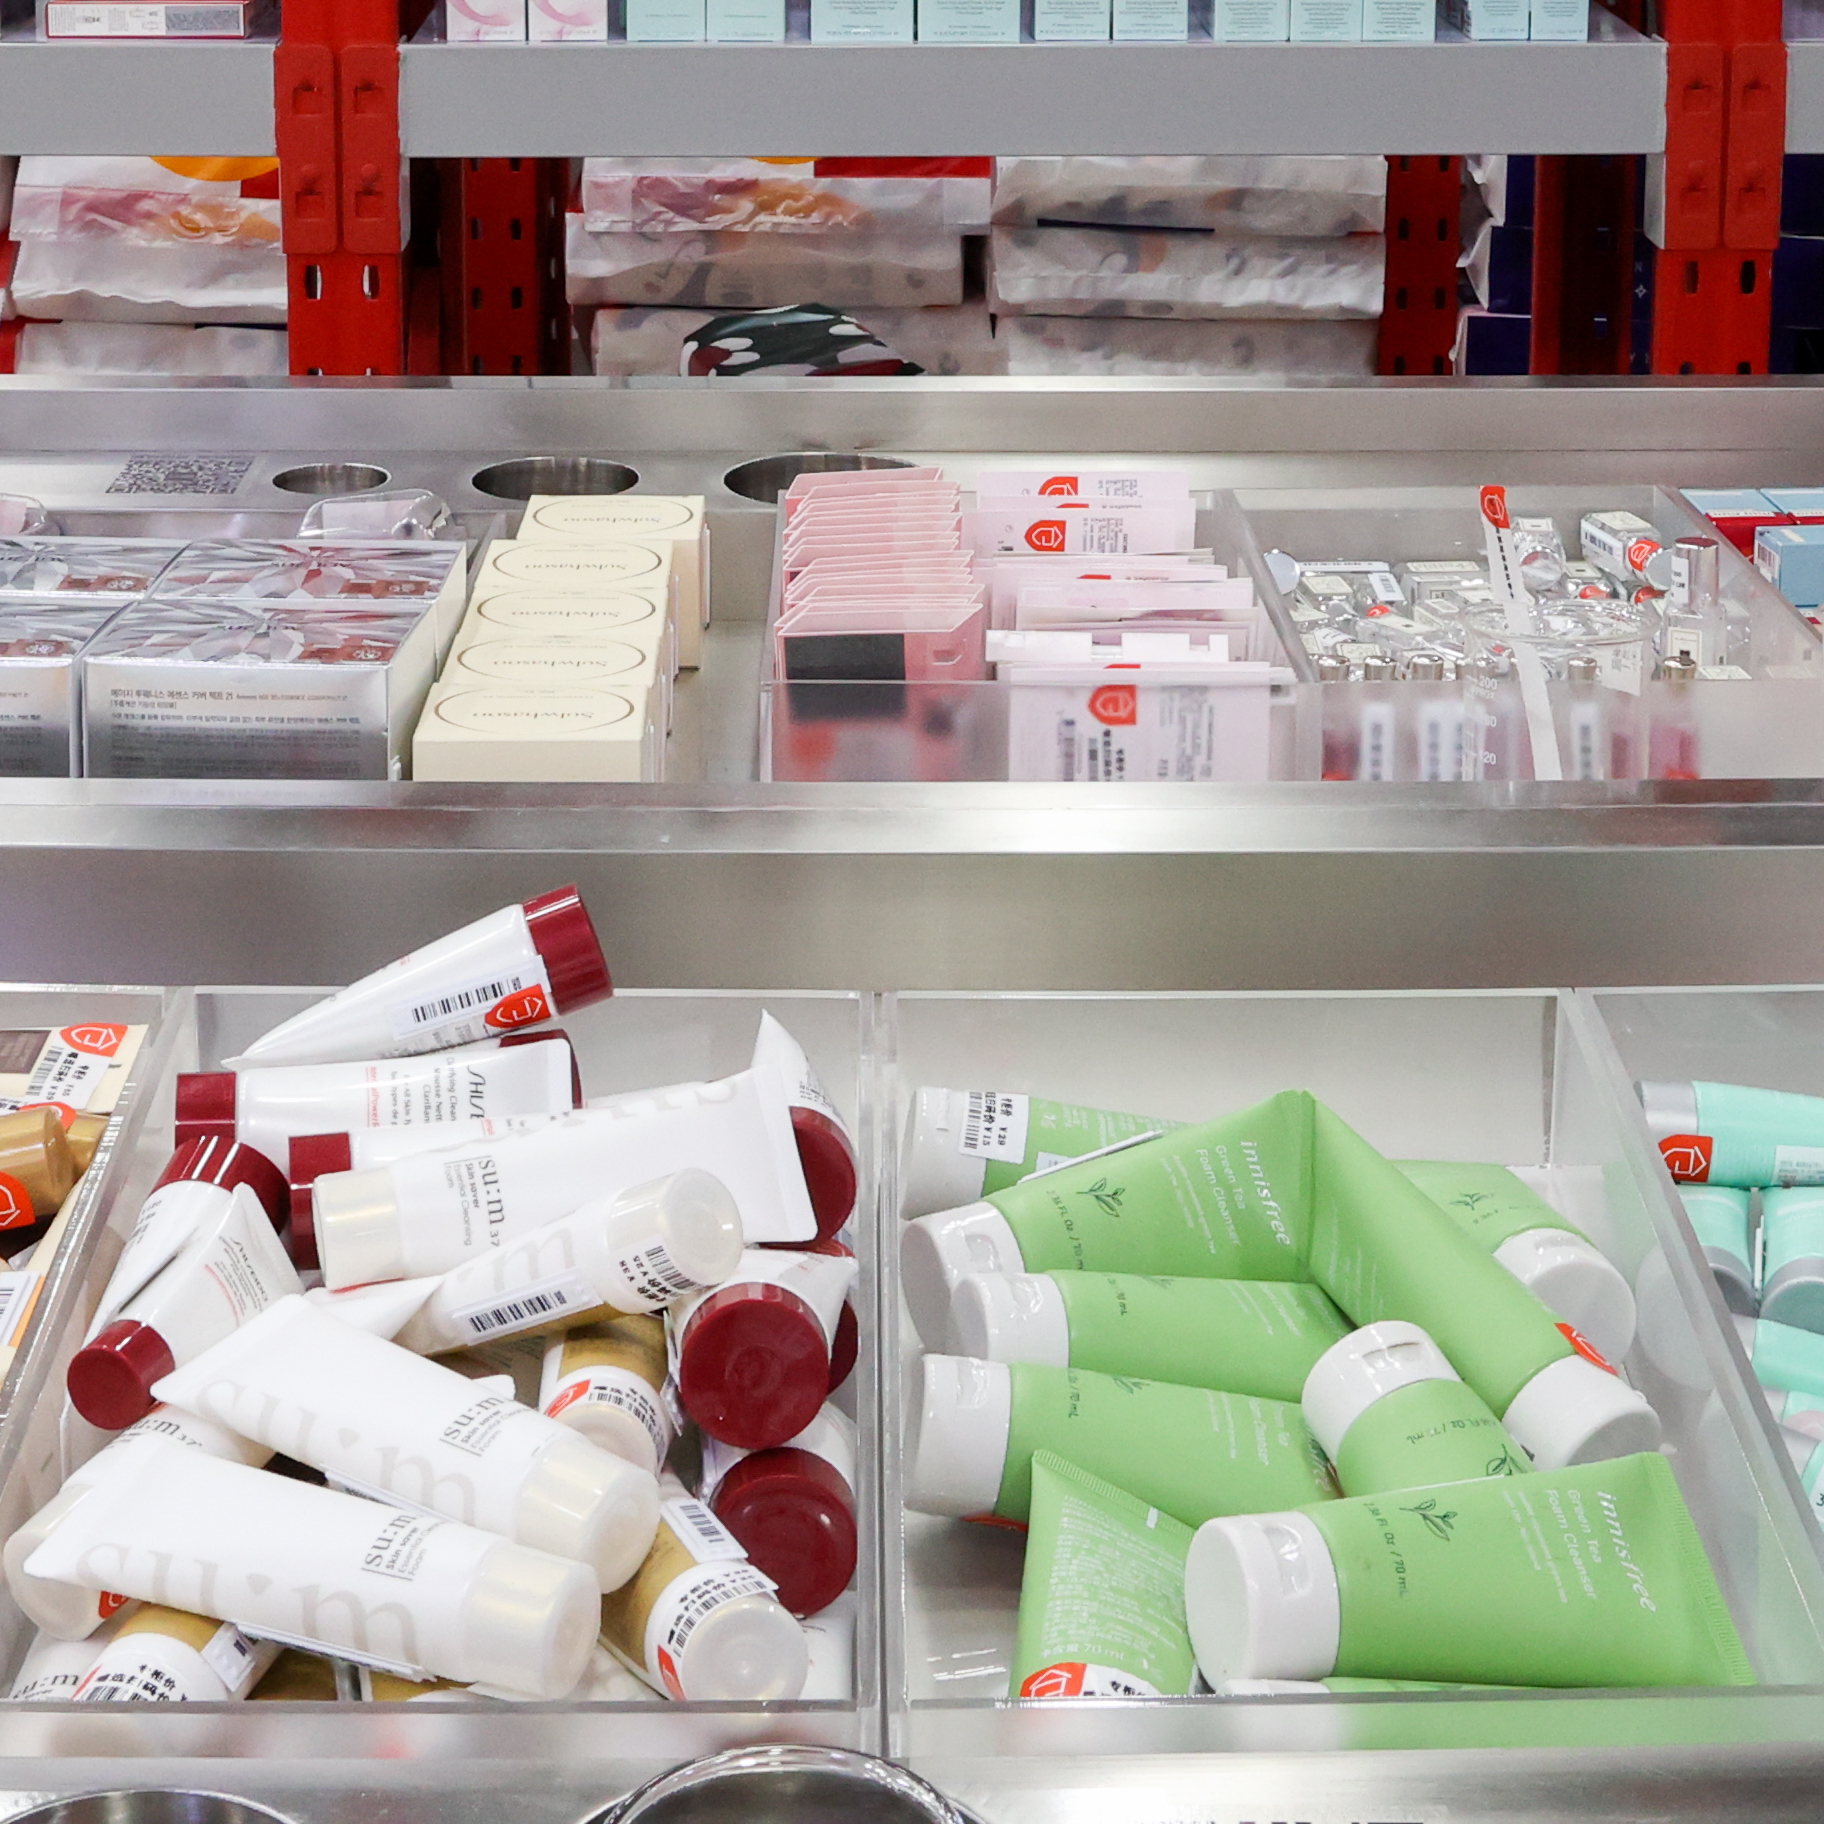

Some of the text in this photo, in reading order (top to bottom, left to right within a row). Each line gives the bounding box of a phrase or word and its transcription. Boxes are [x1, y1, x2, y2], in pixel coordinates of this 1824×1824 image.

[470, 1182, 480, 1209] saver
[1196, 1149, 1241, 1246] Foam Cleanser
[1215, 1145, 1246, 1209] Green Tea
[1239, 1140, 1291, 1246] innisfree
[460, 1199, 472, 1246] Cleansing
[364, 1514, 416, 1567] su:m
[1547, 1489, 1597, 1599] Foam Cleanser
[1567, 1489, 1602, 1563] Green Tea
[1597, 1491, 1656, 1613] innisfree
